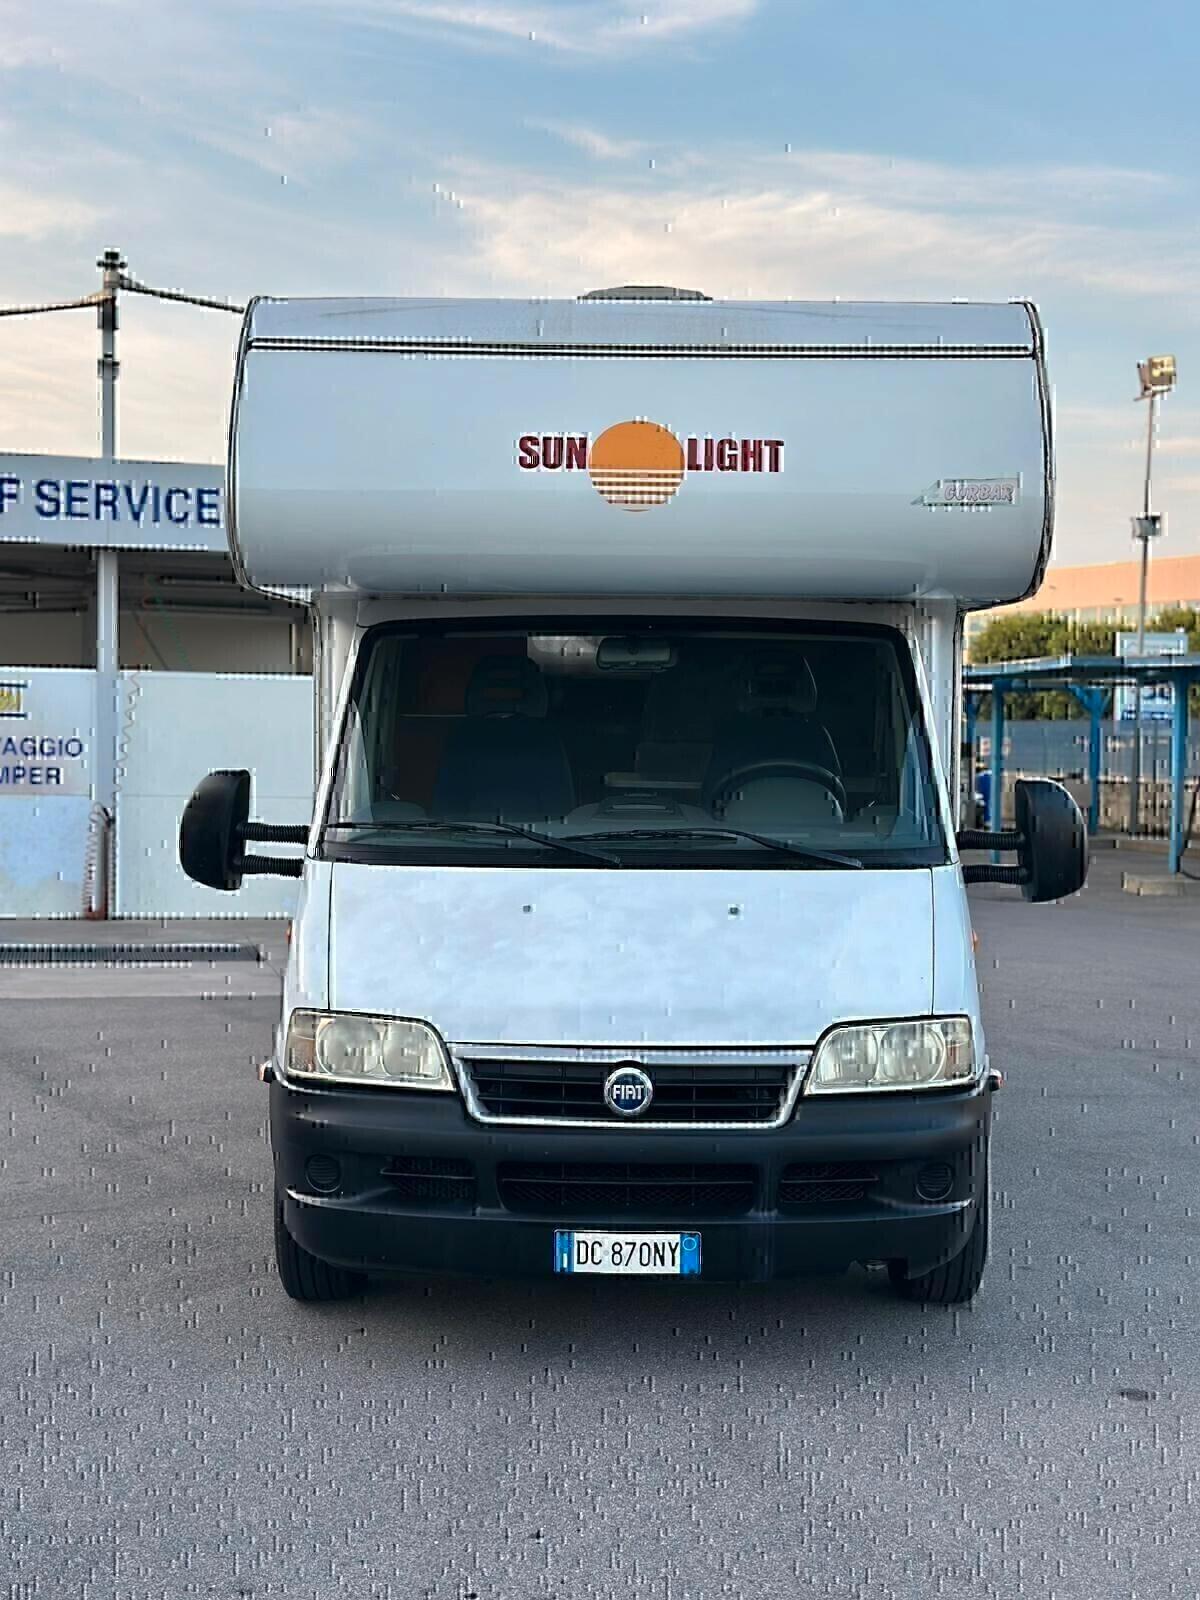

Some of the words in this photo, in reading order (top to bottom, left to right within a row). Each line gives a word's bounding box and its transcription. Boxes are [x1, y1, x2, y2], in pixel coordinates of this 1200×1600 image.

[518, 435, 588, 470] SUN
[687, 438, 785, 473] LIGHT
[35, 479, 221, 524] SERVICE
[0, 736, 83, 758] AGGIO
[612, 1084, 645, 1100] FIAT
[576, 1240, 603, 1265] DC
[611, 1242, 680, 1267] 870NY
